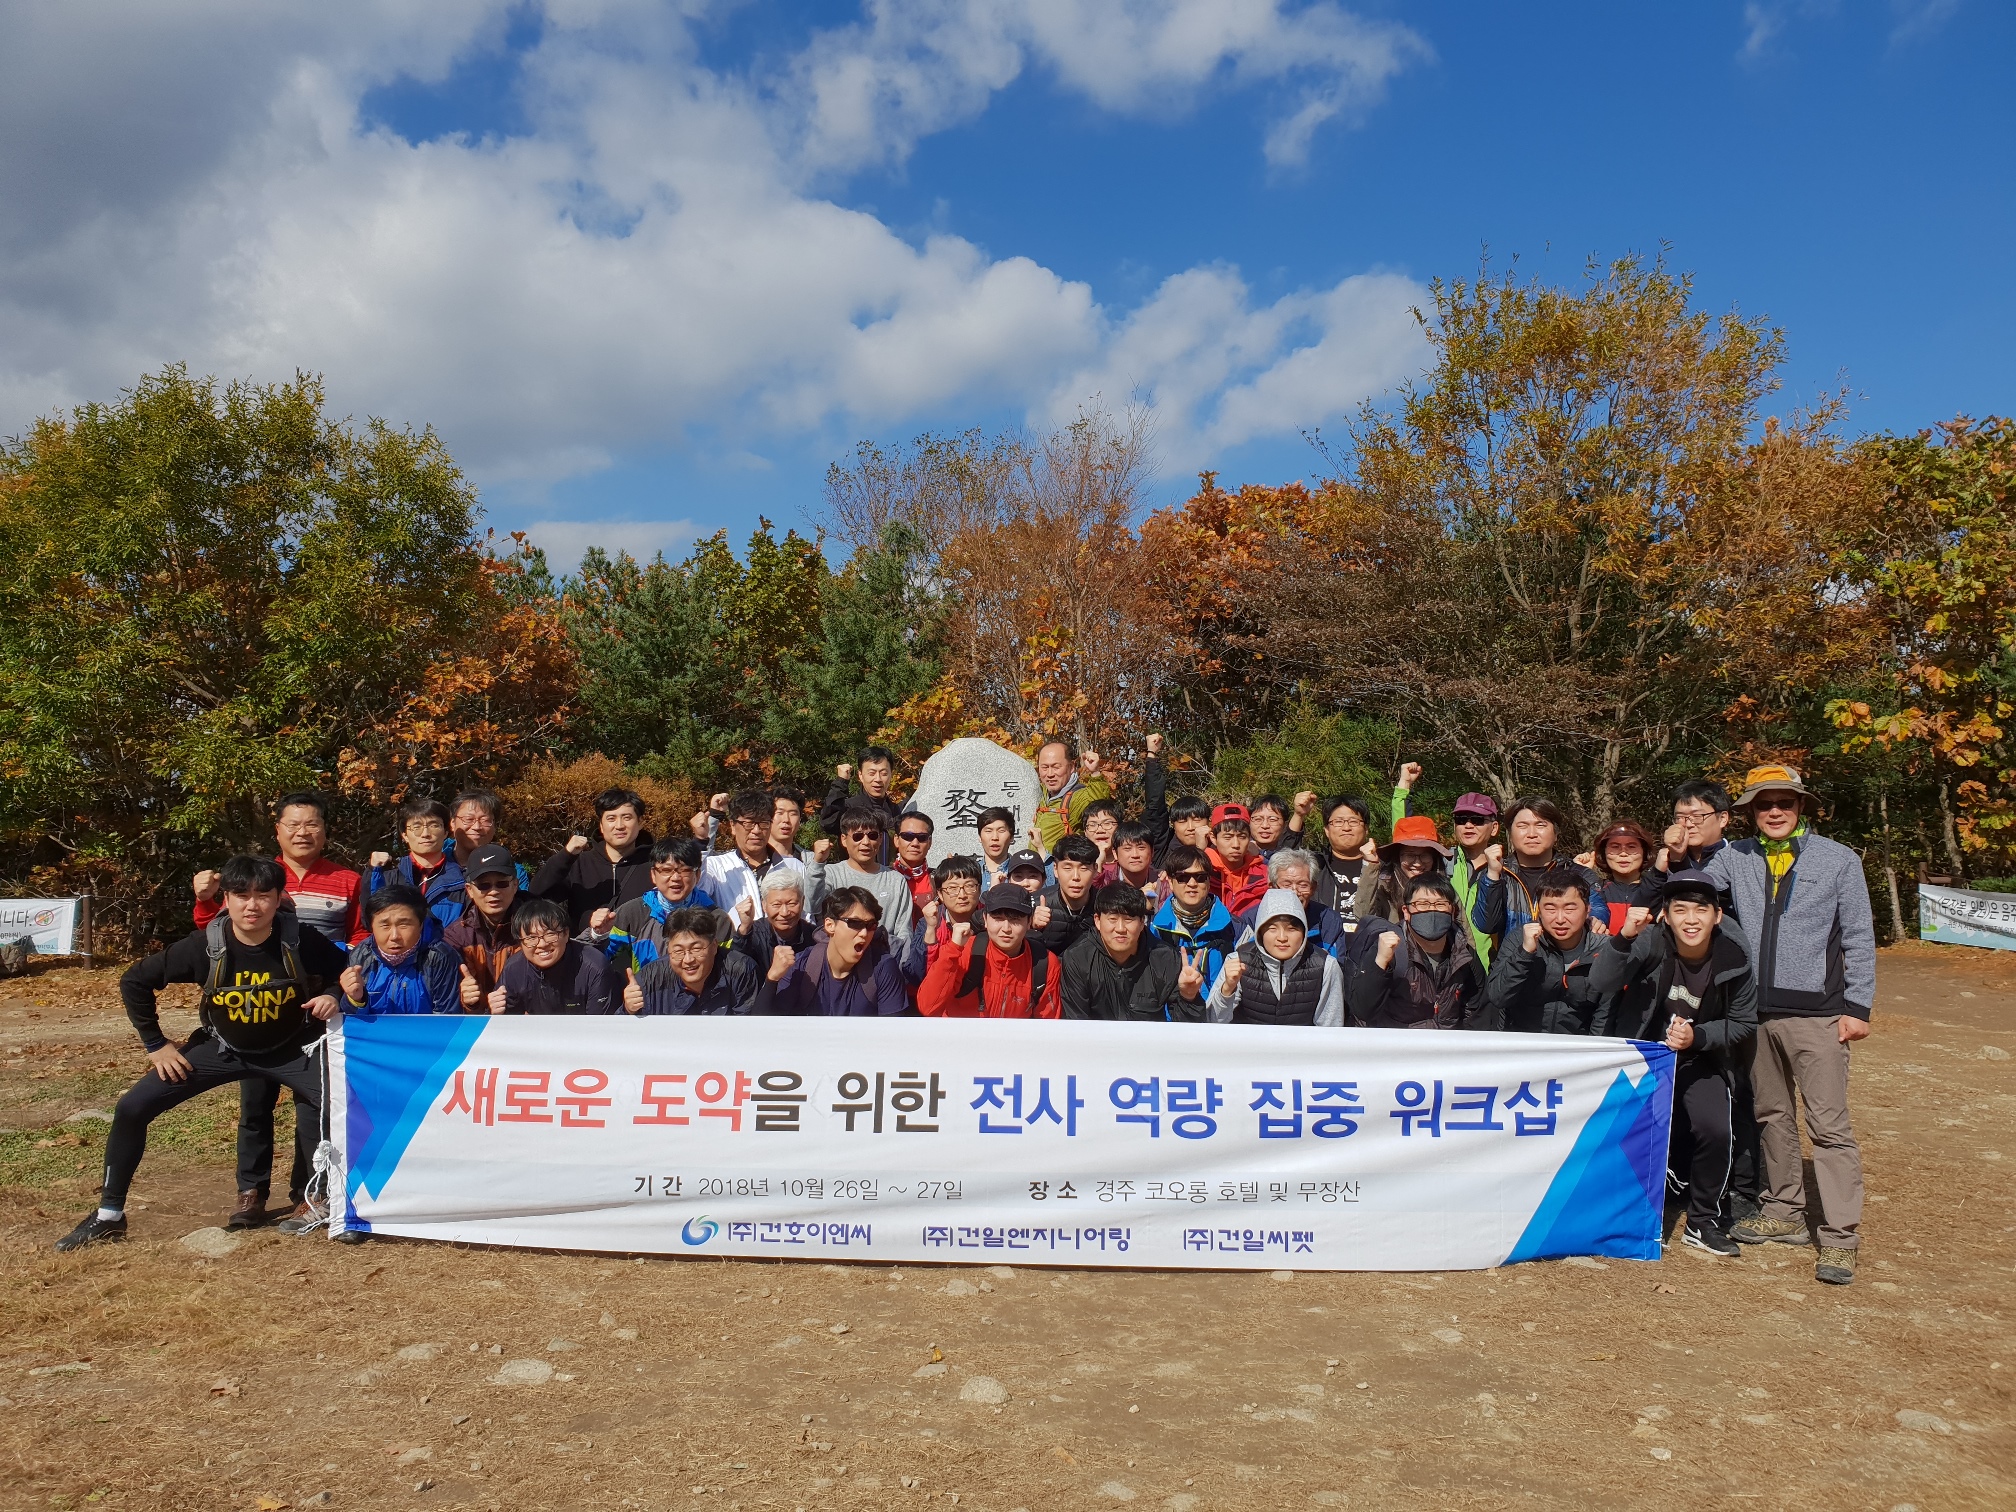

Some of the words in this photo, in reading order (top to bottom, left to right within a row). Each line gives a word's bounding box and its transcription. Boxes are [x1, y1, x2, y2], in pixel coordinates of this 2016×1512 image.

[0, 909, 32, 928] 니다.
[236, 971, 270, 987] I'M
[212, 986, 297, 1009] GONNA
[227, 1006, 280, 1024] WIN
[442, 1068, 612, 1128] 새로운
[633, 1071, 807, 1134] 도약을
[832, 1072, 946, 1135] 위한
[970, 1074, 1084, 1137] 전사
[1109, 1077, 1223, 1140] 역량
[1248, 1078, 1364, 1139] 집중
[1389, 1079, 1564, 1138] 워크샵
[698, 1177, 769, 1198] 2018년
[780, 1178, 824, 1200] 10월
[833, 1179, 879, 1200] 26일
[917, 1180, 963, 1200] 27일
[1095, 1179, 1137, 1202] 경주
[1144, 1181, 1209, 1204] 코오롱
[1216, 1181, 1259, 1203] 호텔
[1269, 1182, 1289, 1203] 및
[1296, 1180, 1361, 1203] 무장산
[728, 1222, 872, 1246] (주)건호이엔씨
[922, 1225, 1131, 1252] (주)건일엔지니어링
[1183, 1228, 1314, 1253] (주)건일씨펫
